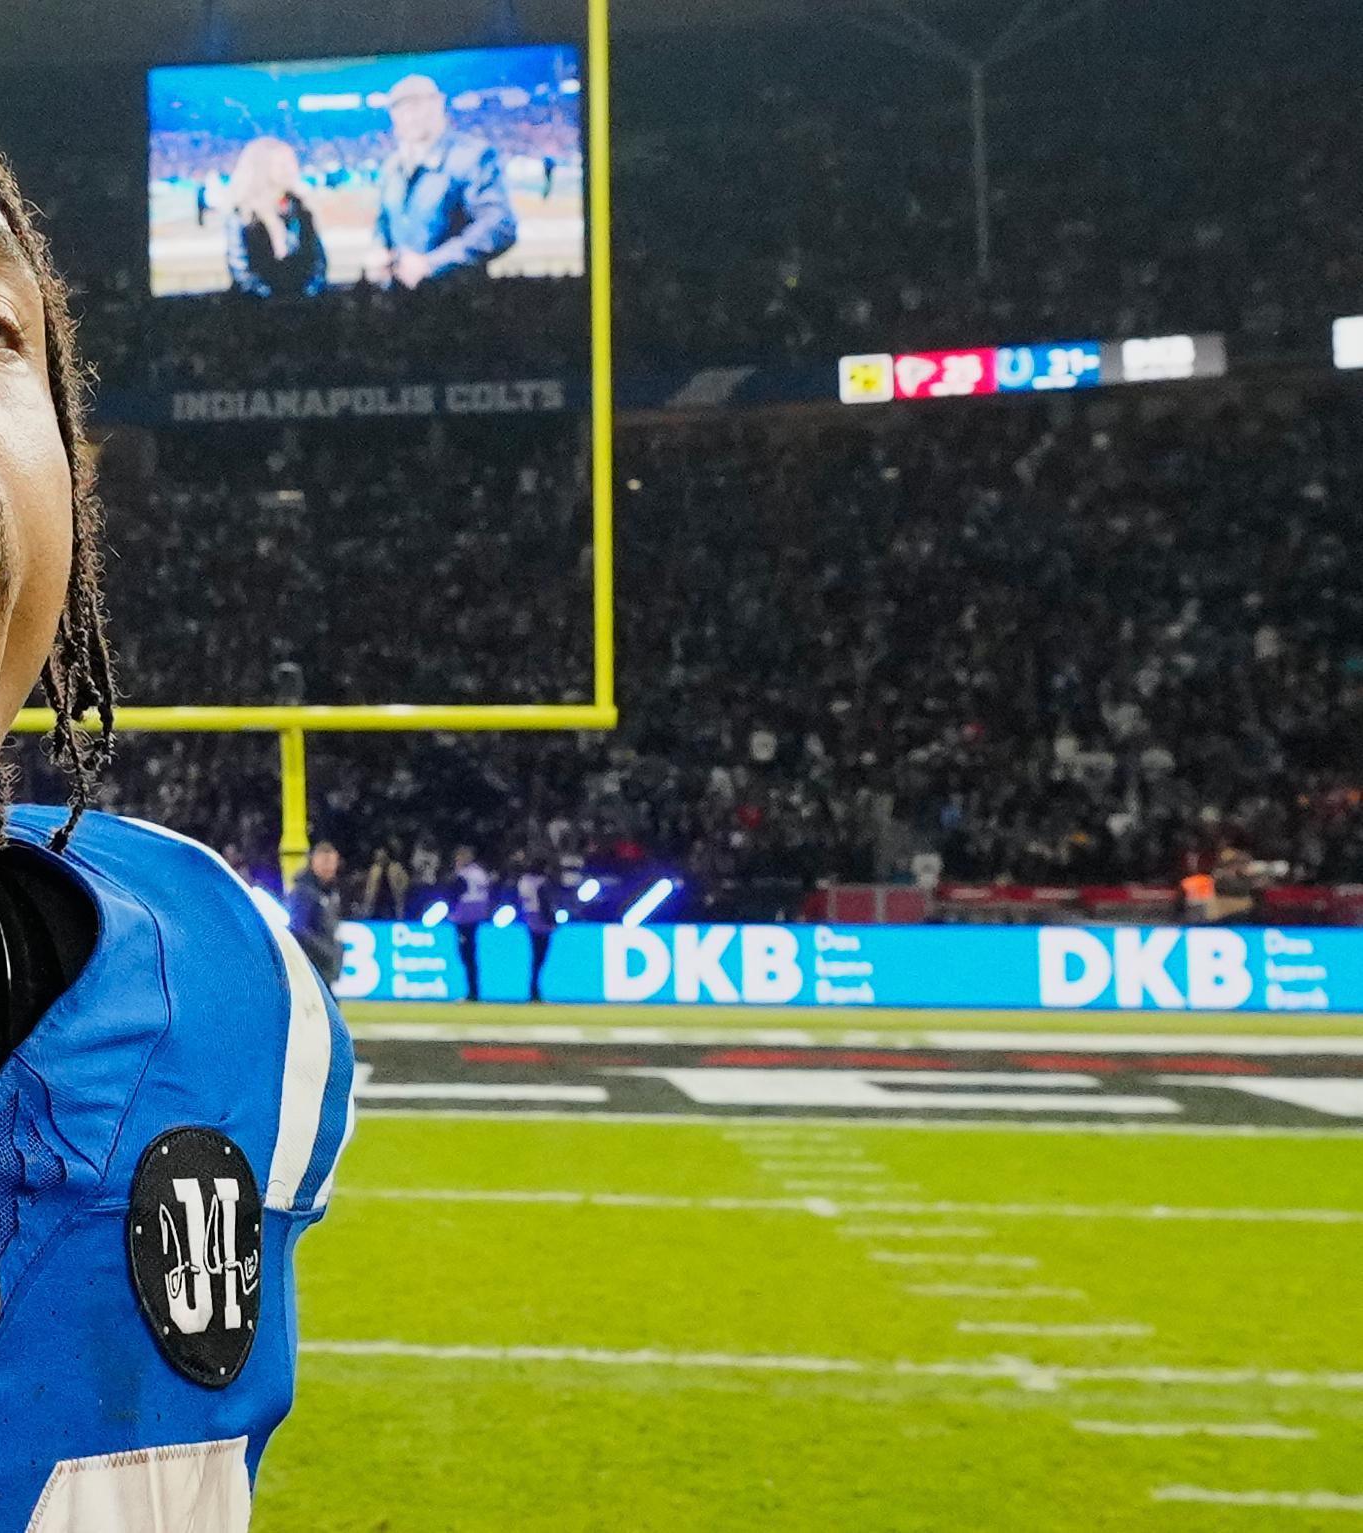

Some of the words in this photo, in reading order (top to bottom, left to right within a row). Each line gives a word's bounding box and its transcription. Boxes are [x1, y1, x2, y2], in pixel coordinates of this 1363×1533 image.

[173, 384, 435, 421] INDIANAPOLIS
[445, 379, 564, 413] COLTS
[602, 923, 804, 1004] DKB
[1037, 926, 1254, 1009] DKB
